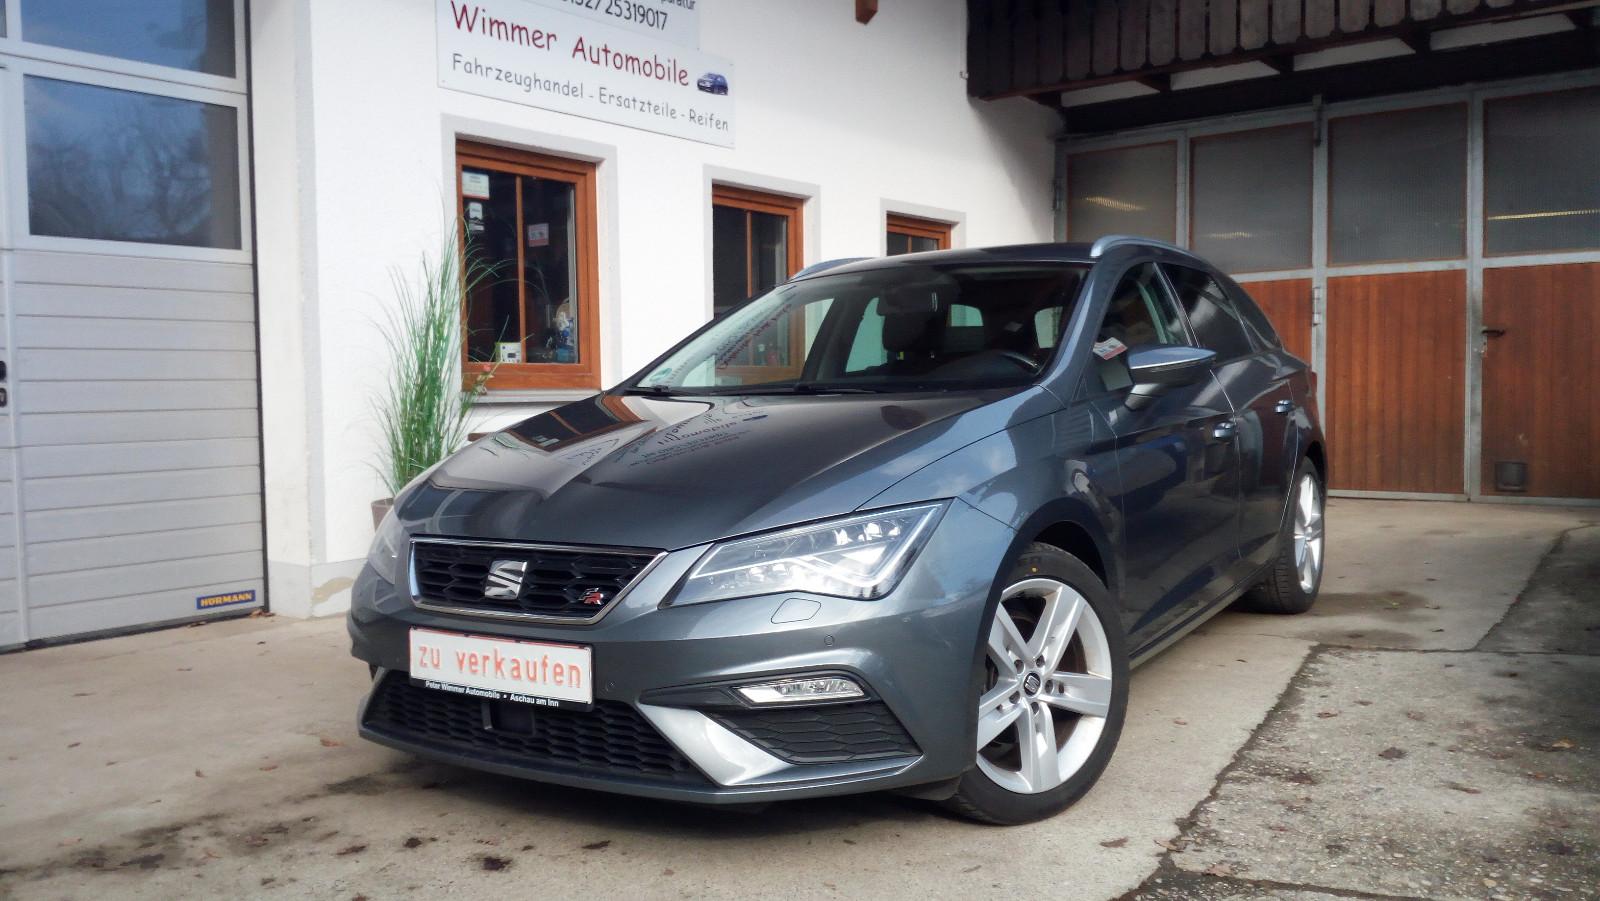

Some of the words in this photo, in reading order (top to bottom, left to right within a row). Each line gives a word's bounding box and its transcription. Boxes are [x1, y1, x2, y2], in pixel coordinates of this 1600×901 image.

[450, 0, 557, 51] Wimmer
[572, 36, 689, 86] Automobile
[452, 52, 583, 99] Fahrzeughandel
[600, 86, 678, 119] Ersatzteile
[689, 108, 728, 131] Reifen
[419, 646, 441, 670] zu
[456, 648, 582, 689] verkaufen
[425, 680, 440, 689] Peter
[441, 683, 465, 694] Wimmer
[465, 687, 501, 700] Automobile
[510, 693, 535, 704] Aschau
[536, 698, 547, 706] am
[548, 699, 559, 708] Inn
